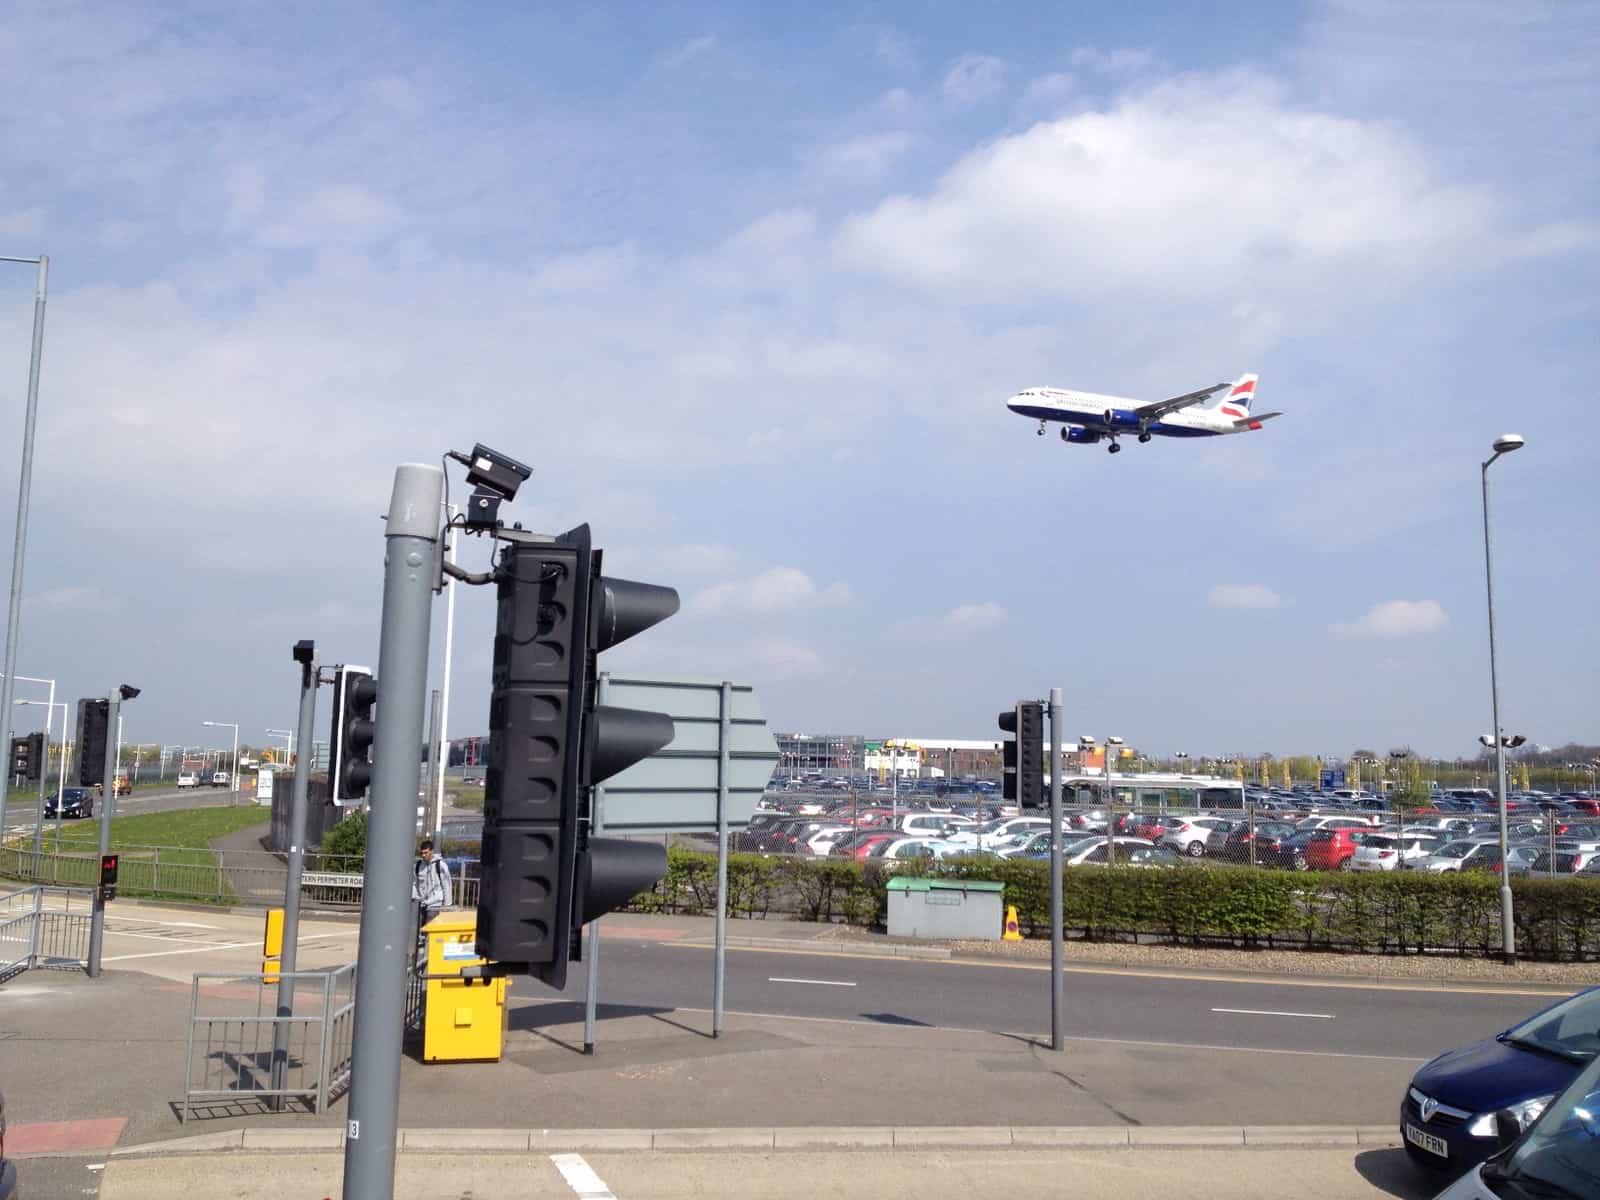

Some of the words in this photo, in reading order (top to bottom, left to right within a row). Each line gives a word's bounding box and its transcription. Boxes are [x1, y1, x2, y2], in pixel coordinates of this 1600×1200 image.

[318, 876, 348, 885] PERIMETER
[350, 877, 363, 886] ROA
[1426, 1135, 1444, 1154] FRN
